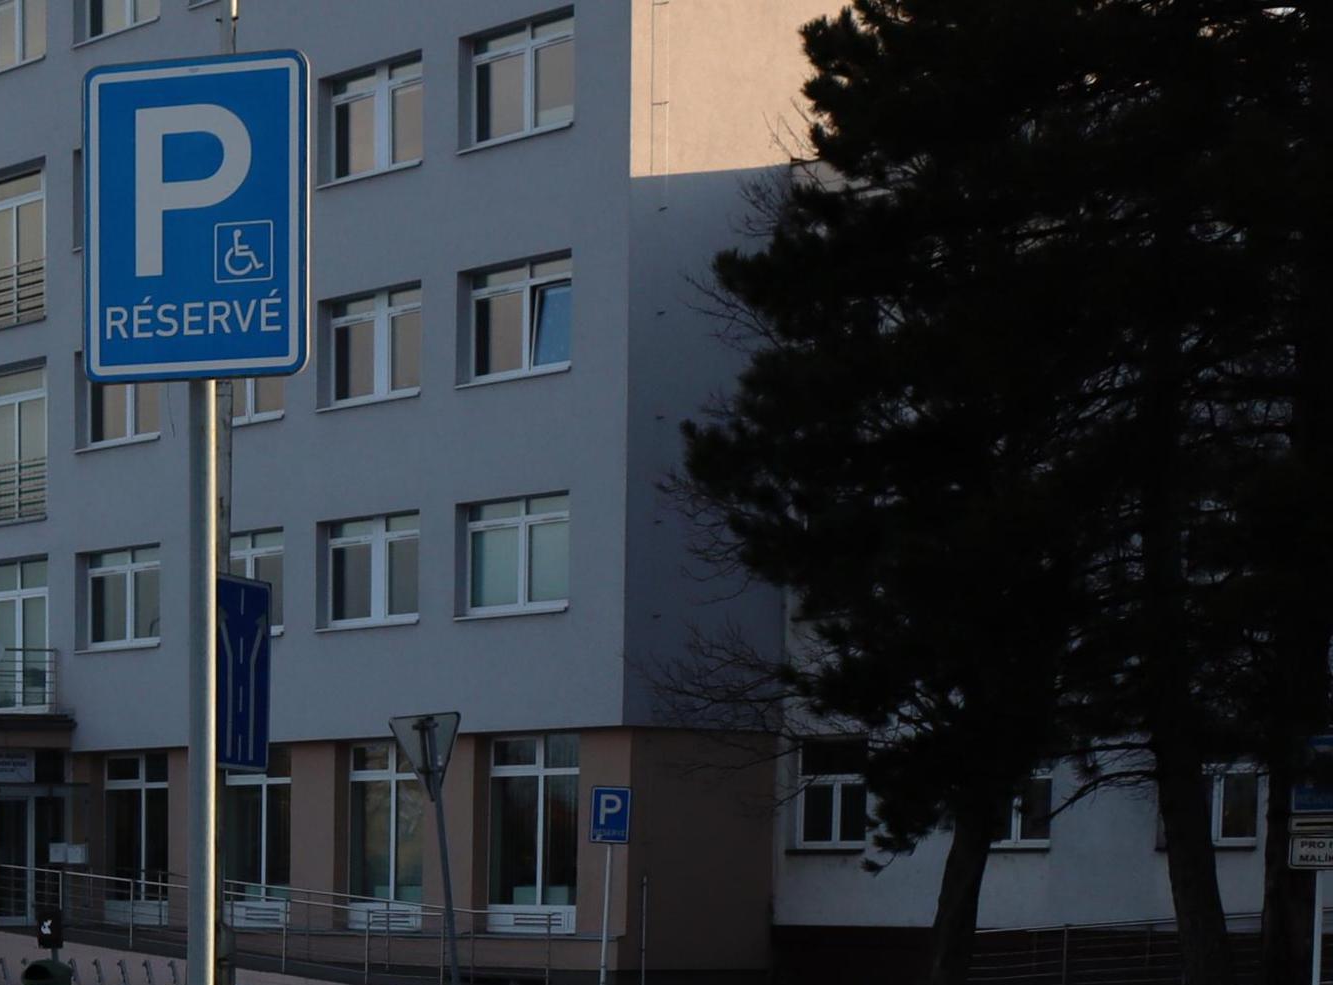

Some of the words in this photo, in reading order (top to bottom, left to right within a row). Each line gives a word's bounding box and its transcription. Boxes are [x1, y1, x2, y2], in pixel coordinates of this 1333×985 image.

[134, 103, 252, 278] P
[105, 288, 282, 340] RÉSERVÉ
[599, 794, 622, 825] P
